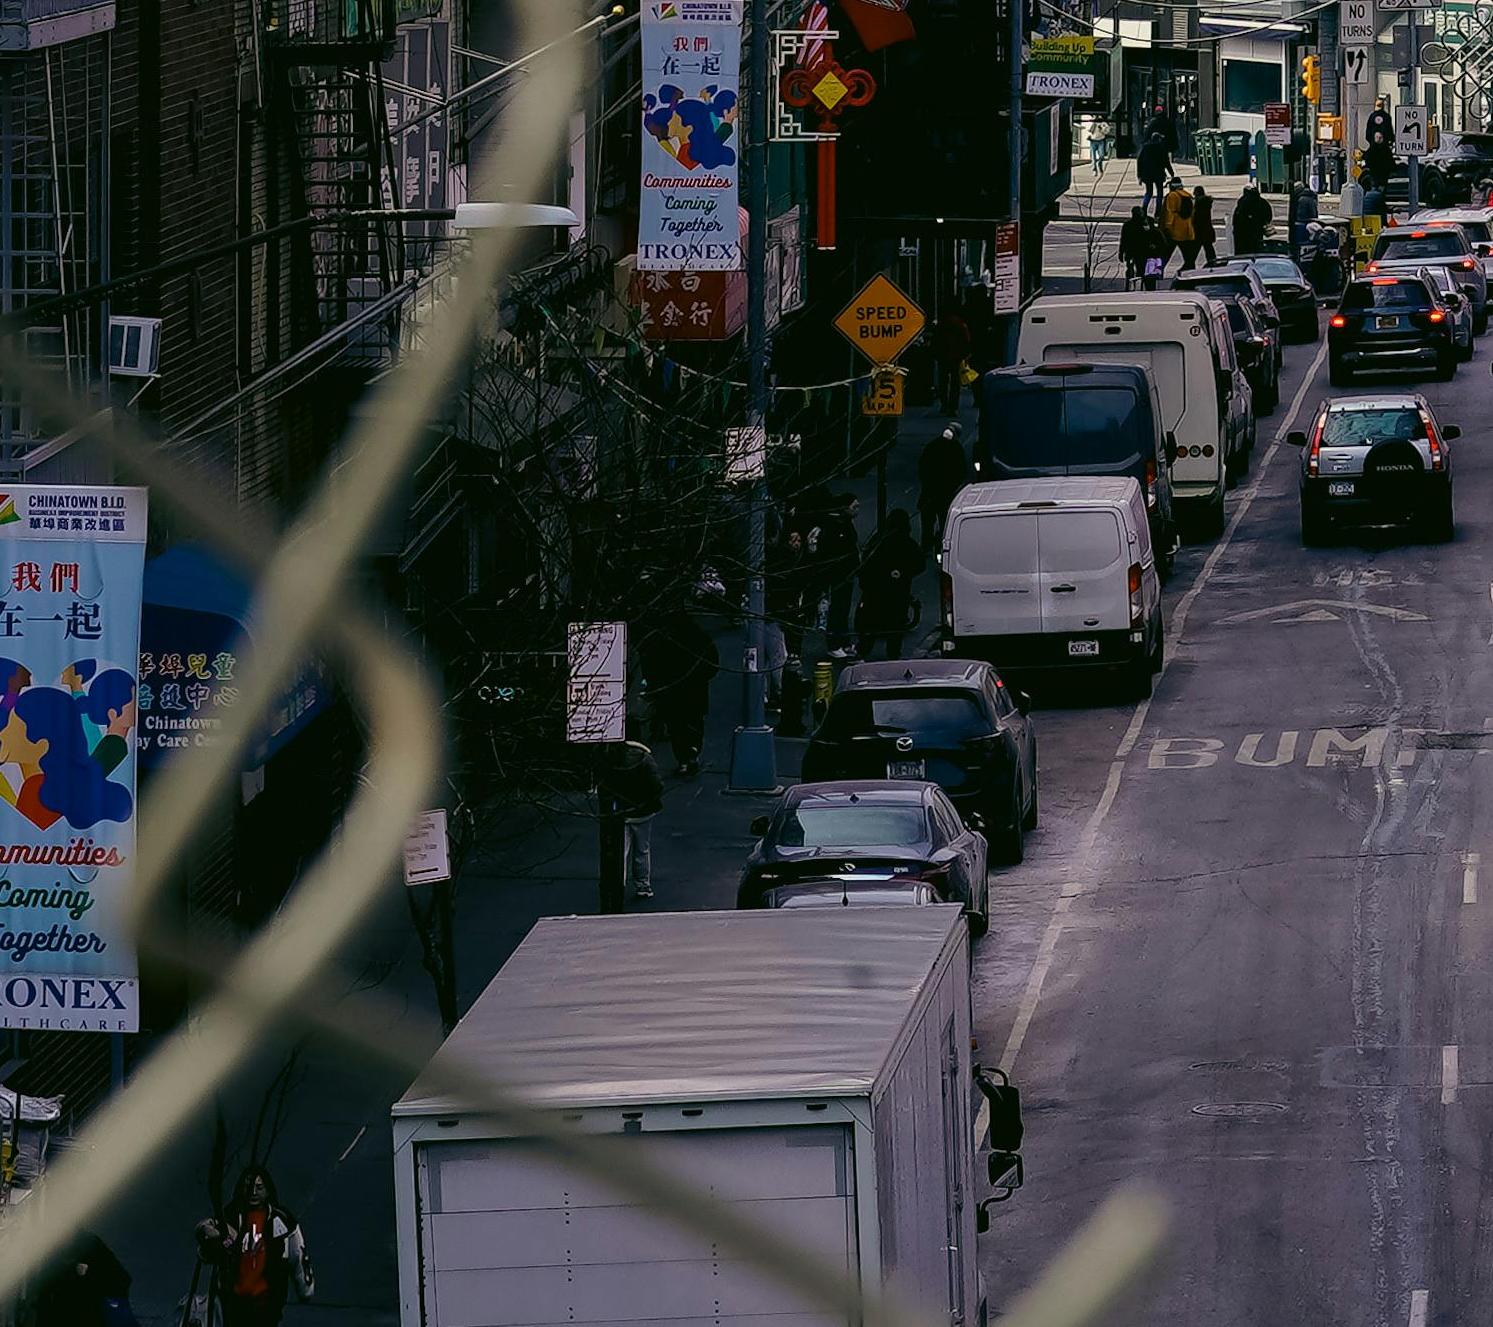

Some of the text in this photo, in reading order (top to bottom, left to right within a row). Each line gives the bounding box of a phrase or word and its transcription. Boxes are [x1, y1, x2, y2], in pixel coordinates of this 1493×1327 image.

[1349, 4, 1366, 19] NO
[1341, 25, 1373, 37] TURNS
[673, 37, 711, 53] 我們
[1071, 44, 1086, 56] Up
[662, 55, 721, 76] 在一起
[1030, 76, 1089, 90] TRONEX
[1404, 111, 1419, 120] NO
[1399, 141, 1424, 151] TURN
[643, 173, 733, 189] Communities
[664, 195, 718, 215] Coming
[660, 214, 724, 237] Together
[640, 243, 735, 260] TRONEX
[857, 306, 907, 321] SPEED
[860, 324, 903, 339] BUMP
[1375, 464, 1414, 472] HONDA
[28, 495, 127, 509] CHINATOWN B.I.D.
[28, 517, 126, 532] 華埠商業改進區
[11, 561, 80, 594] 我們
[145, 716, 221, 730] Chinatown
[157, 733, 190, 747] Care
